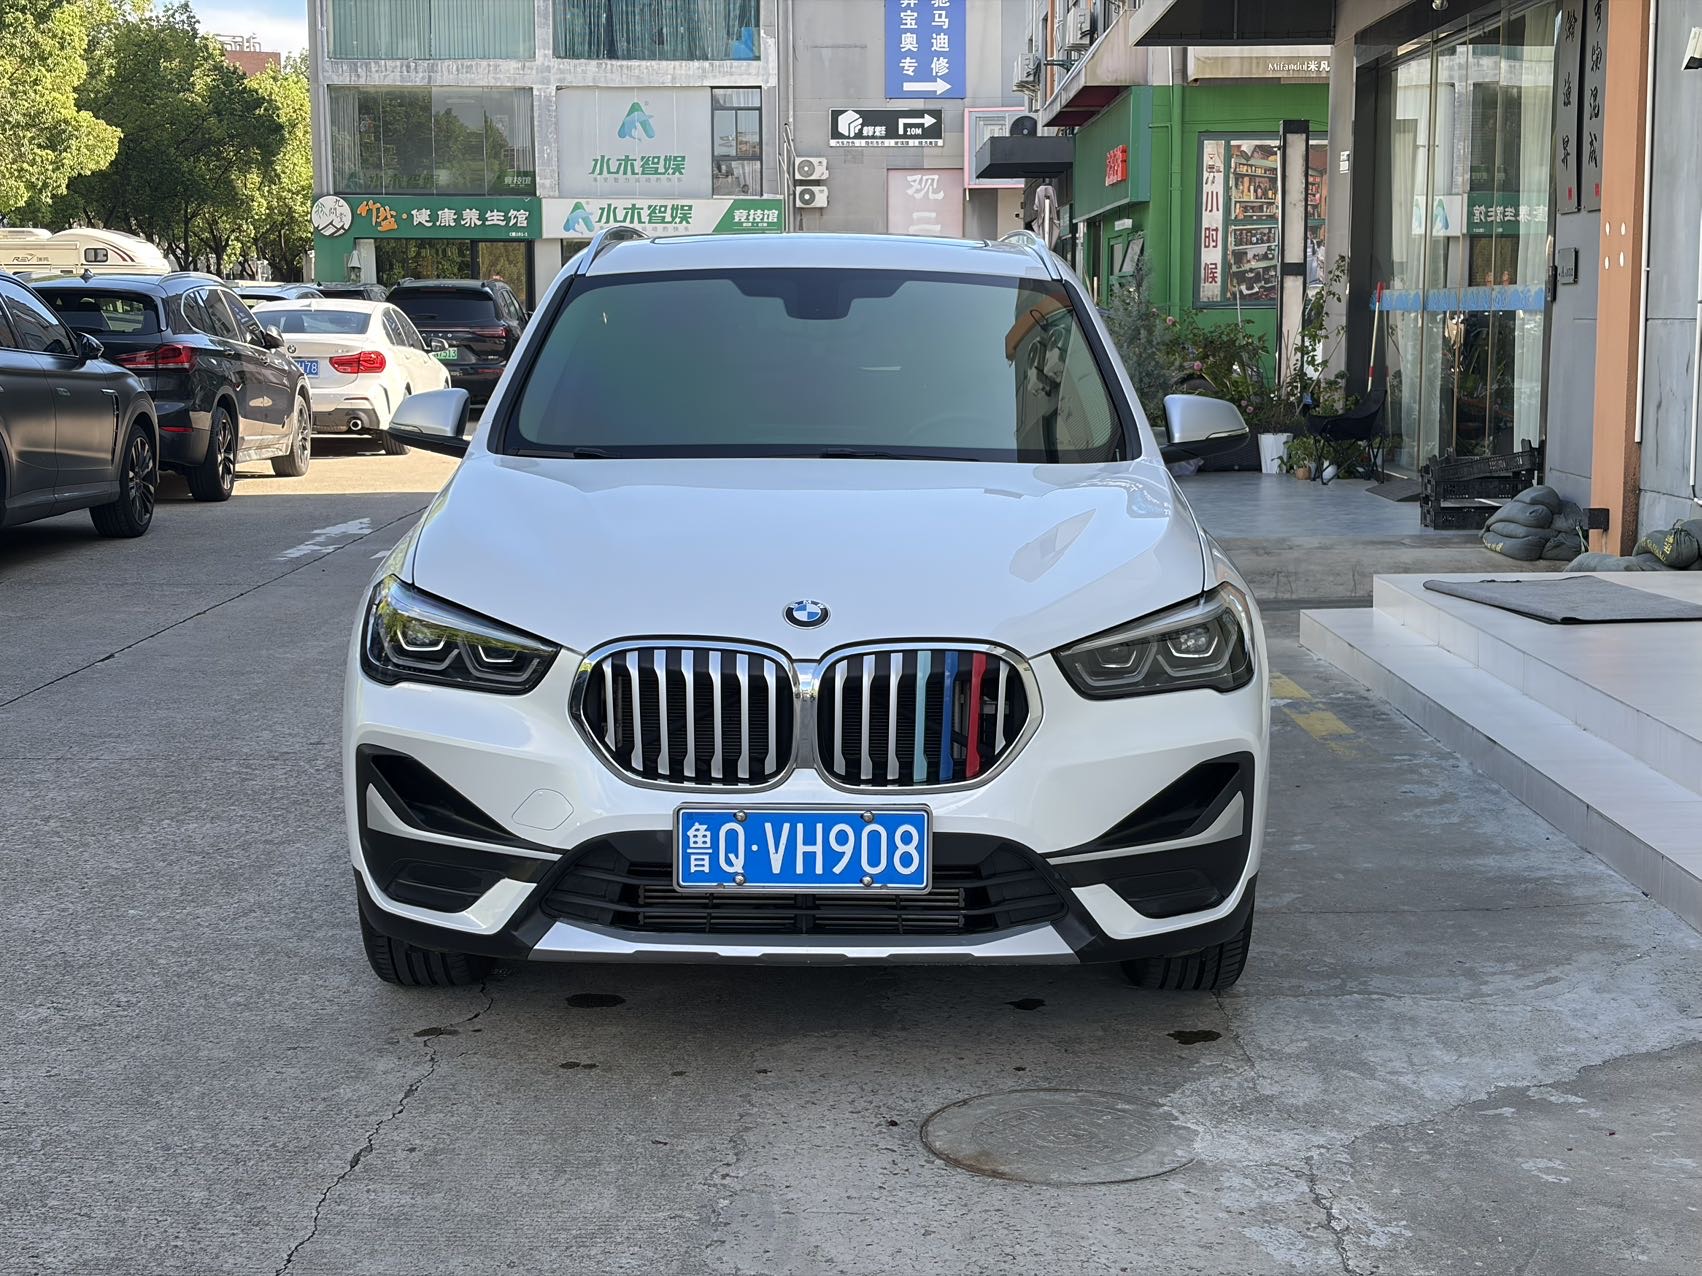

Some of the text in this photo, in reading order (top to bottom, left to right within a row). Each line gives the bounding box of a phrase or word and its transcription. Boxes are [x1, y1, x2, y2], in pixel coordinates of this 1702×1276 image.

[900, 10, 949, 29] 宝马
[900, 32, 949, 52] 奥迪
[899, 56, 949, 77] 专修
[906, 127, 922, 135] 10M
[589, 154, 686, 176] 水木智娱
[595, 203, 693, 225] 水木智娱
[733, 209, 778, 222] 竞技馆
[686, 821, 920, 875] 鲁Q·VH908
